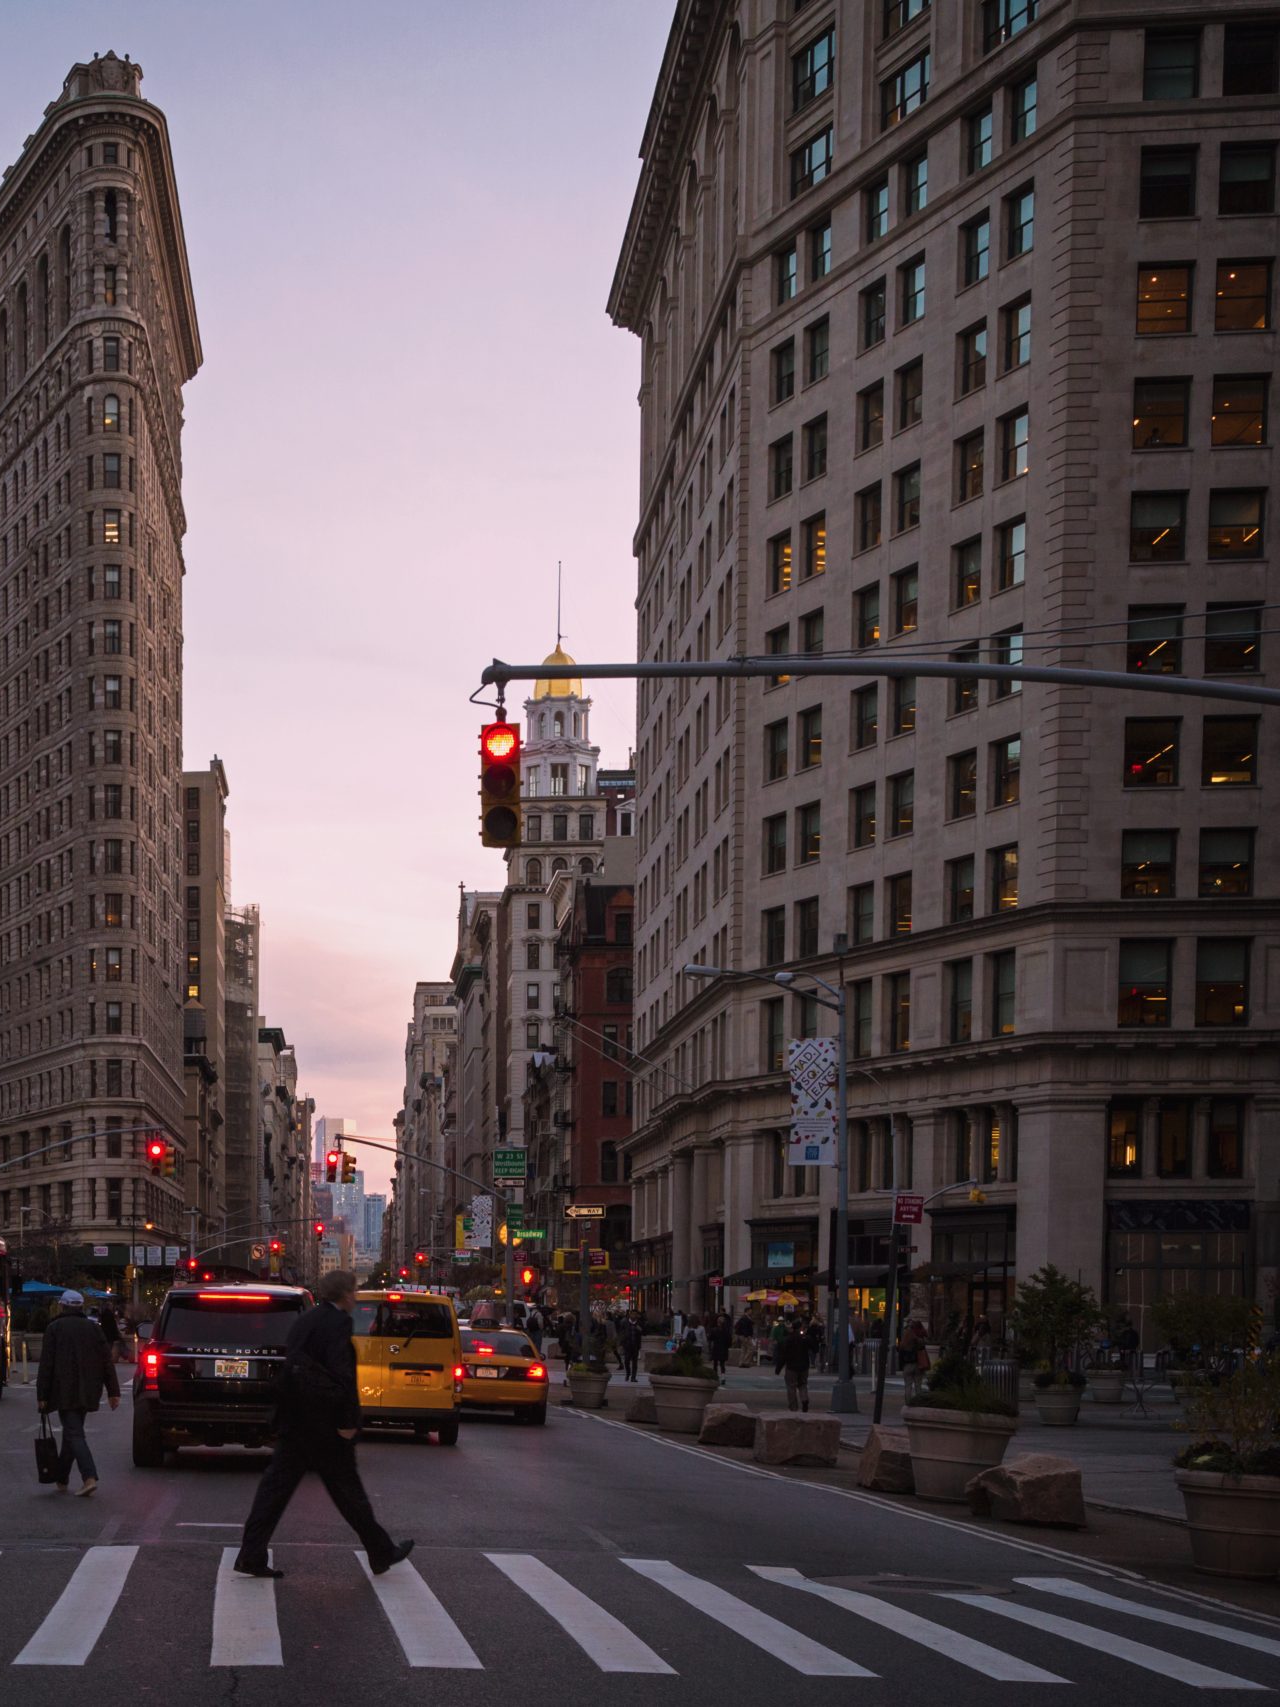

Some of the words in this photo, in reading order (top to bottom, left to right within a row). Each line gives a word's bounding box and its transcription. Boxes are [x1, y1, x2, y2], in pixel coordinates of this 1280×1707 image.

[790, 1051, 816, 1077] MAD.
[801, 1070, 820, 1086] SQ.
[811, 1071, 836, 1097] EATS
[517, 1230, 543, 1239] Broadway
